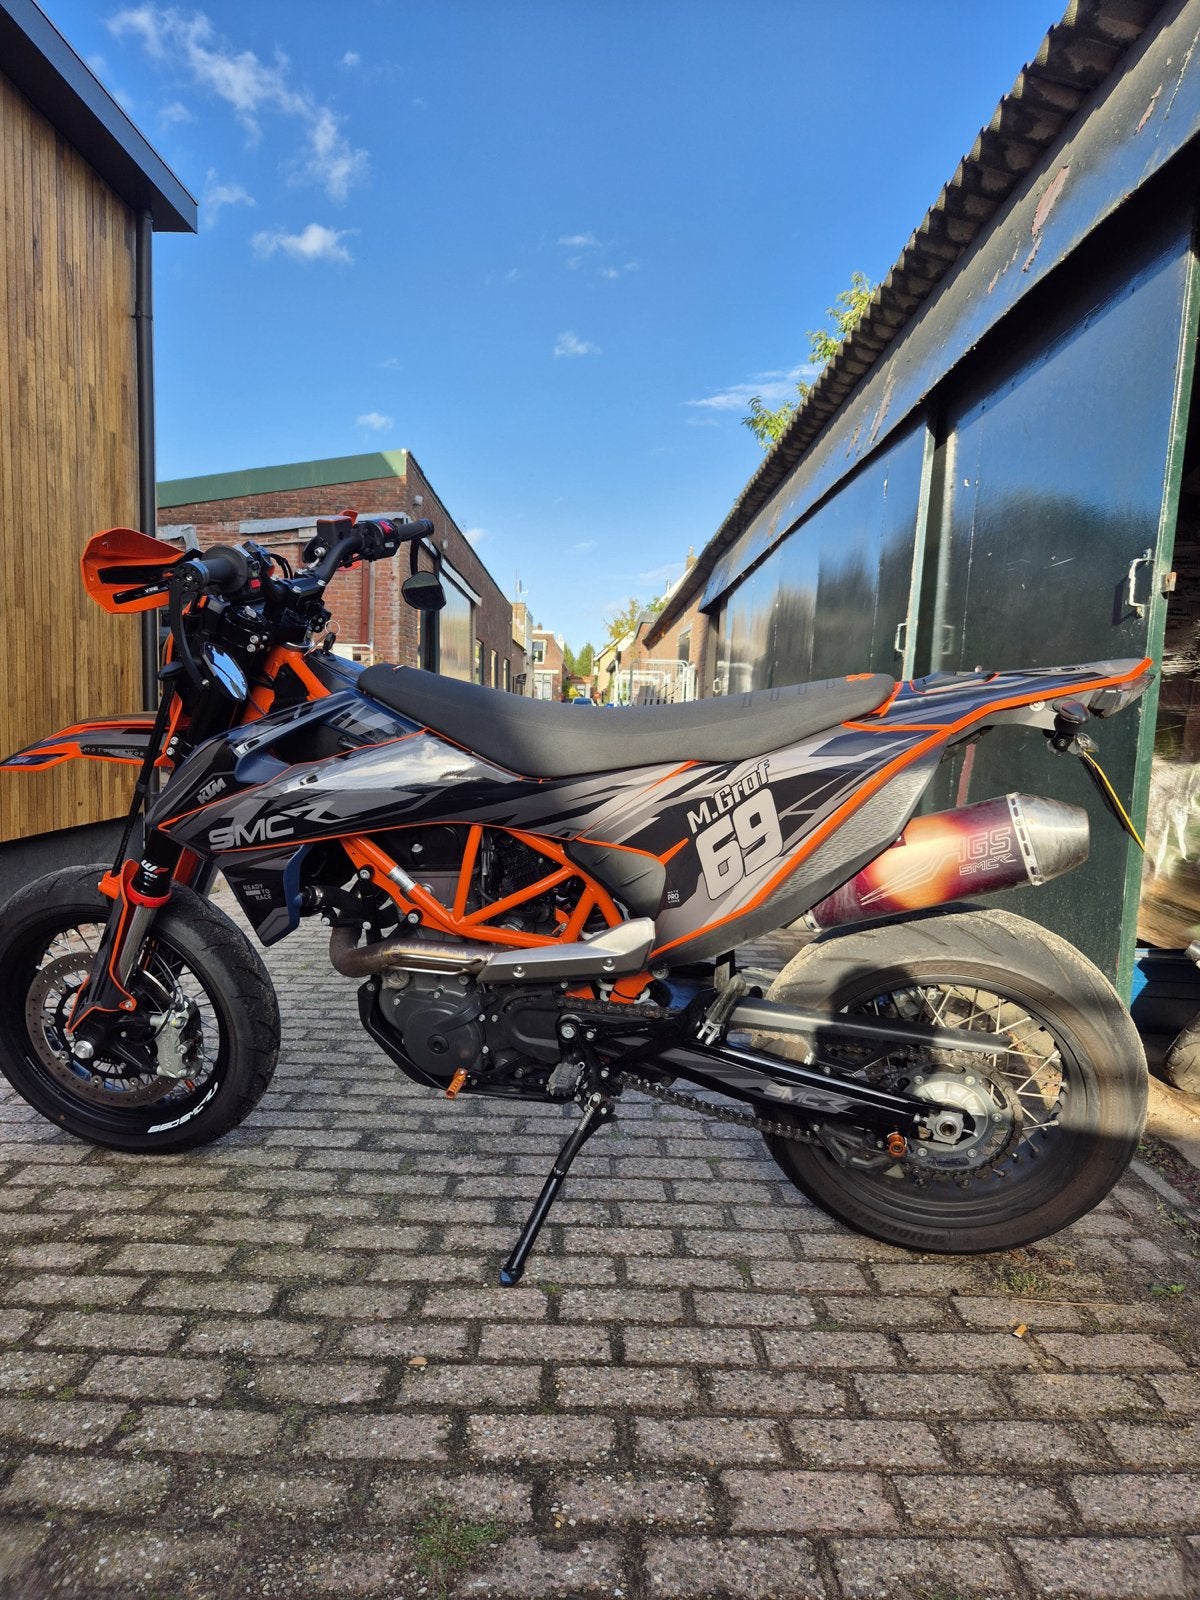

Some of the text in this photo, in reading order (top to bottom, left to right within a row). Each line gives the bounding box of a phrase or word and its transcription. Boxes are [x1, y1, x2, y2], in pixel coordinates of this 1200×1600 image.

[196, 777, 227, 805] KTM
[696, 788, 783, 900] 69
[242, 883, 263, 891] READY
[255, 893, 273, 901] RACE
[667, 893, 680, 901] PRO
